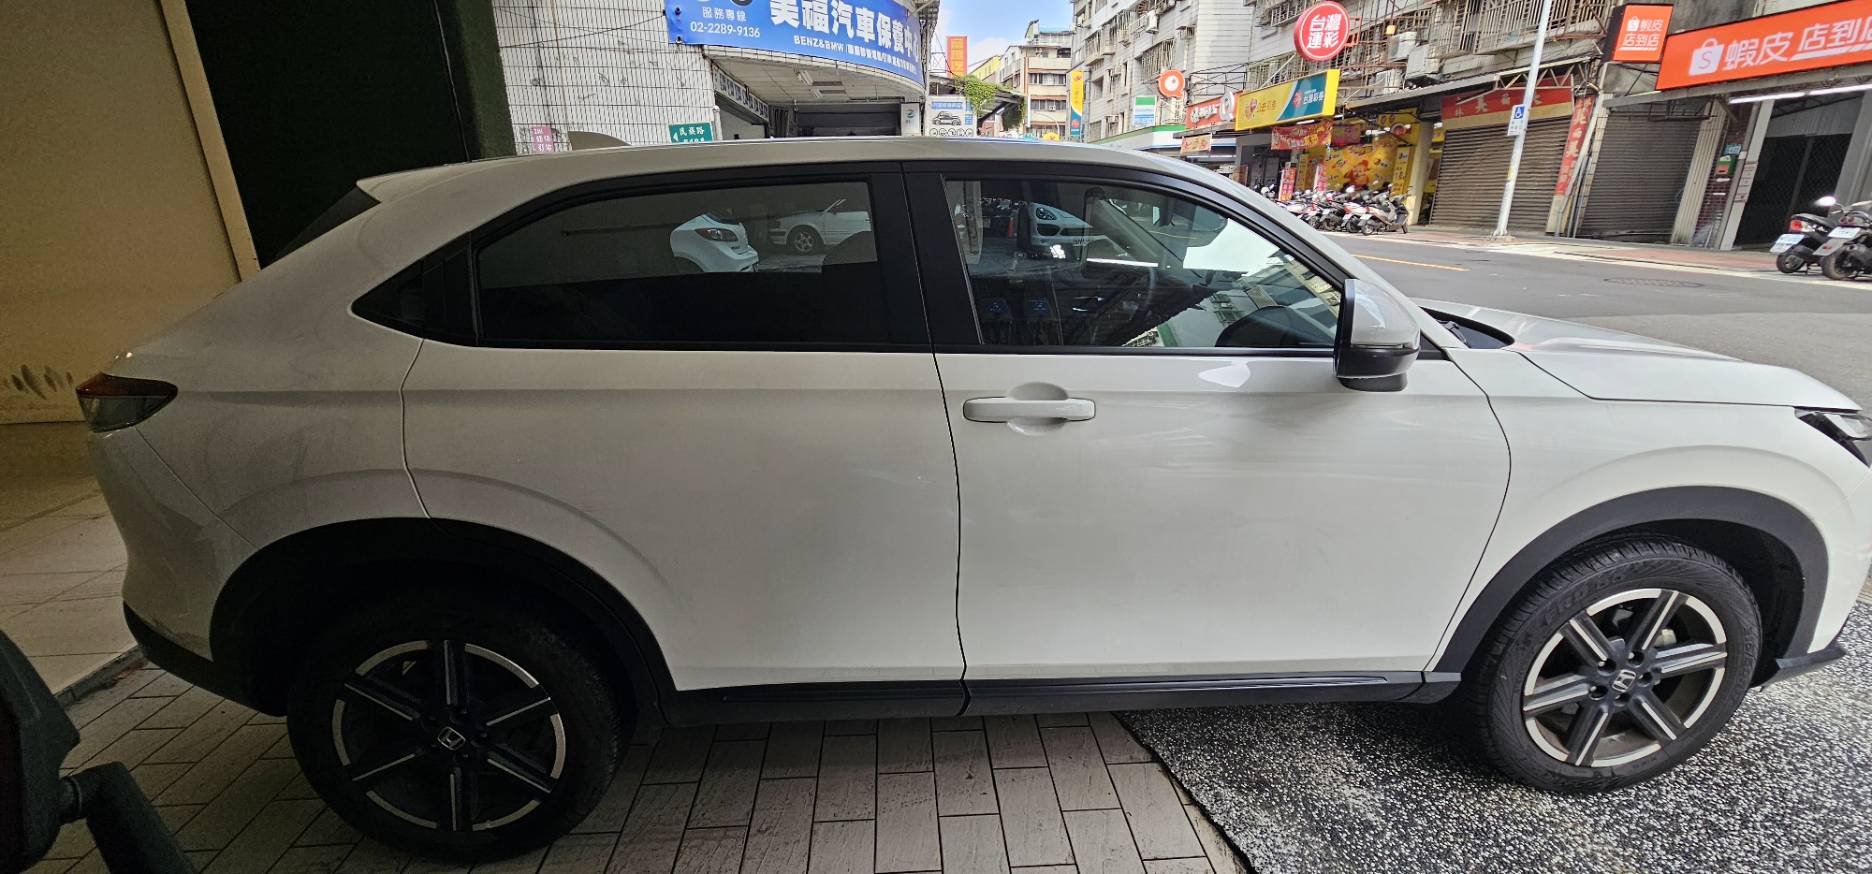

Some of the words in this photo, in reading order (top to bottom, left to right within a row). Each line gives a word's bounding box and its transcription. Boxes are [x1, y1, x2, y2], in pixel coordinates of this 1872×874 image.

[702, 7, 746, 21] 服務專線
[690, 21, 760, 38] 02-2289-9136
[1310, 13, 1342, 31] 台灣
[1640, 19, 1664, 31] 蝦皮
[1307, 31, 1340, 48] 運彩
[1623, 33, 1660, 47] 店到店
